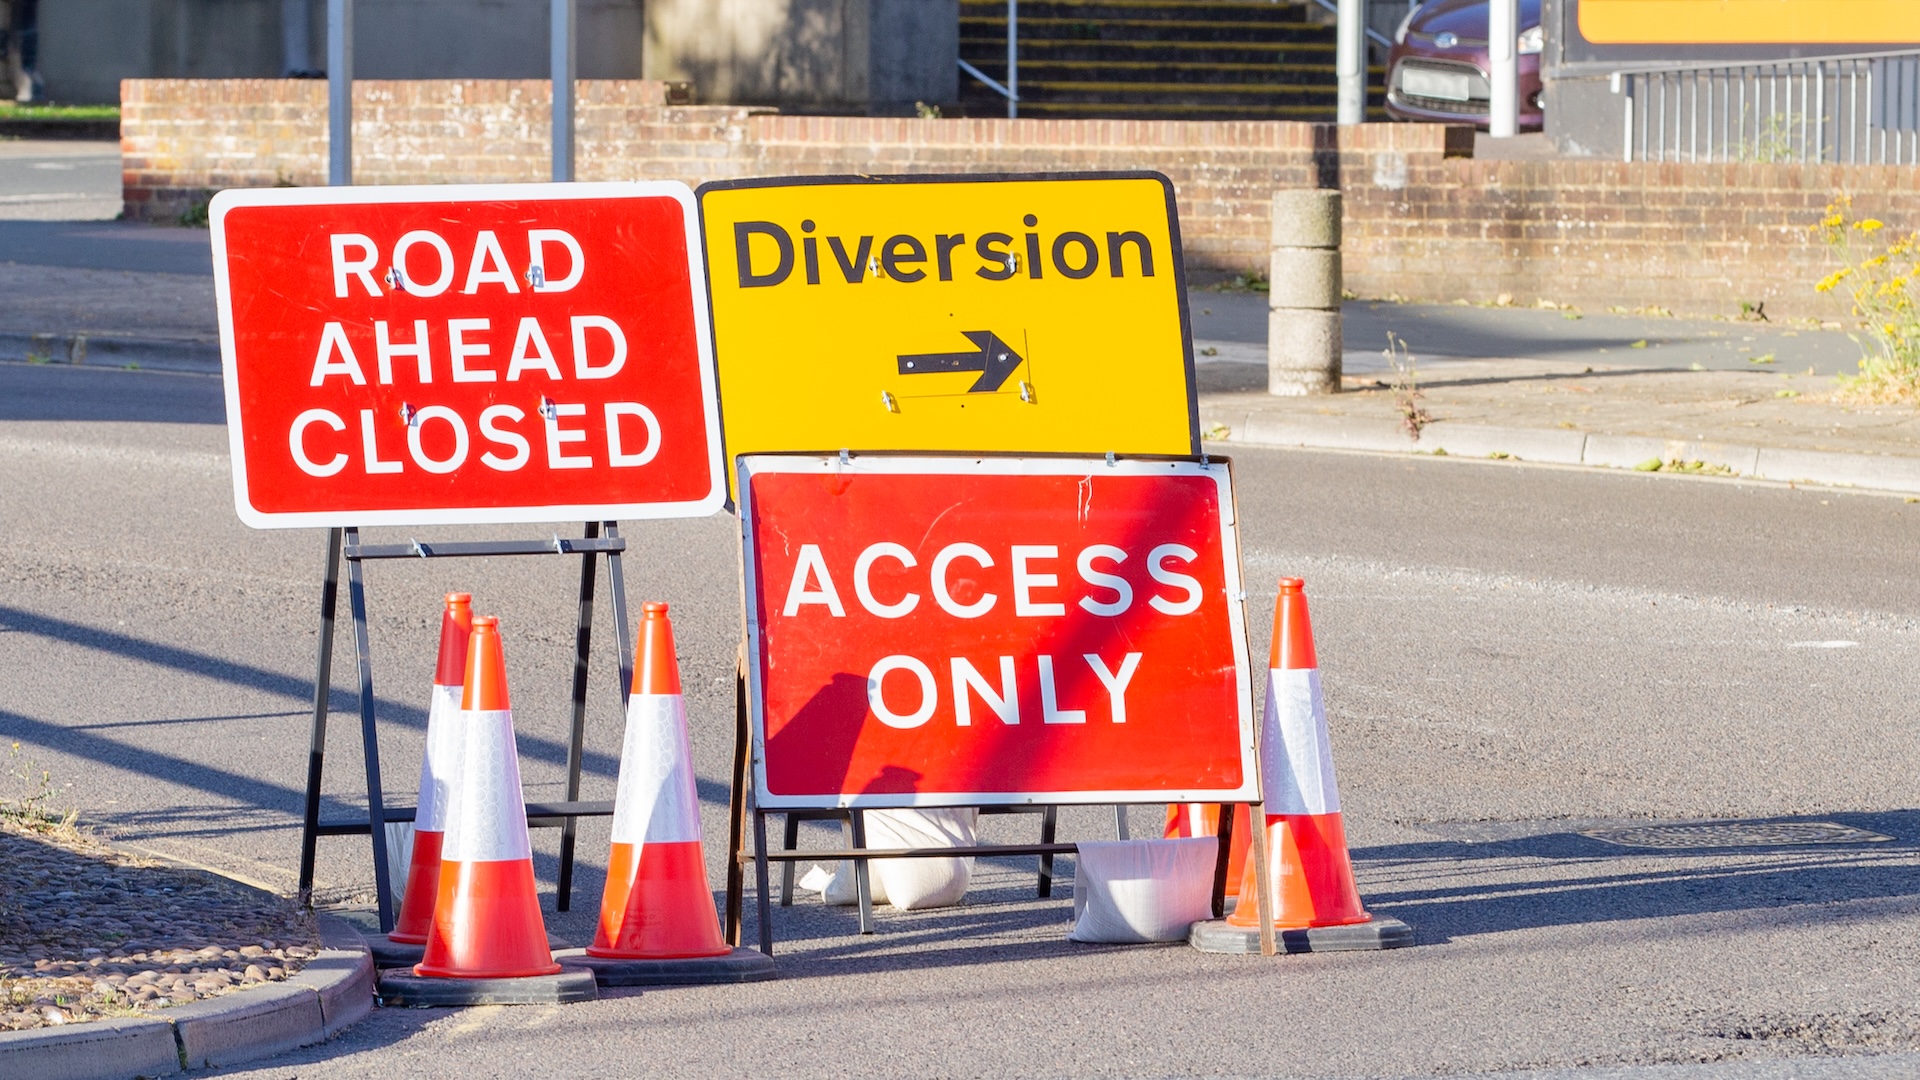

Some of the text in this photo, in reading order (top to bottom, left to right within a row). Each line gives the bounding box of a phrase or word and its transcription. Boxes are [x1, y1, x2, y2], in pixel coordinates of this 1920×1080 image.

[330, 229, 585, 297] ROAD
[734, 214, 1155, 288] Diversion
[310, 316, 628, 387] AHEAD
[289, 401, 662, 477] CLOSED
[783, 542, 1204, 619] ACCESS
[867, 651, 1143, 729] ONLY
